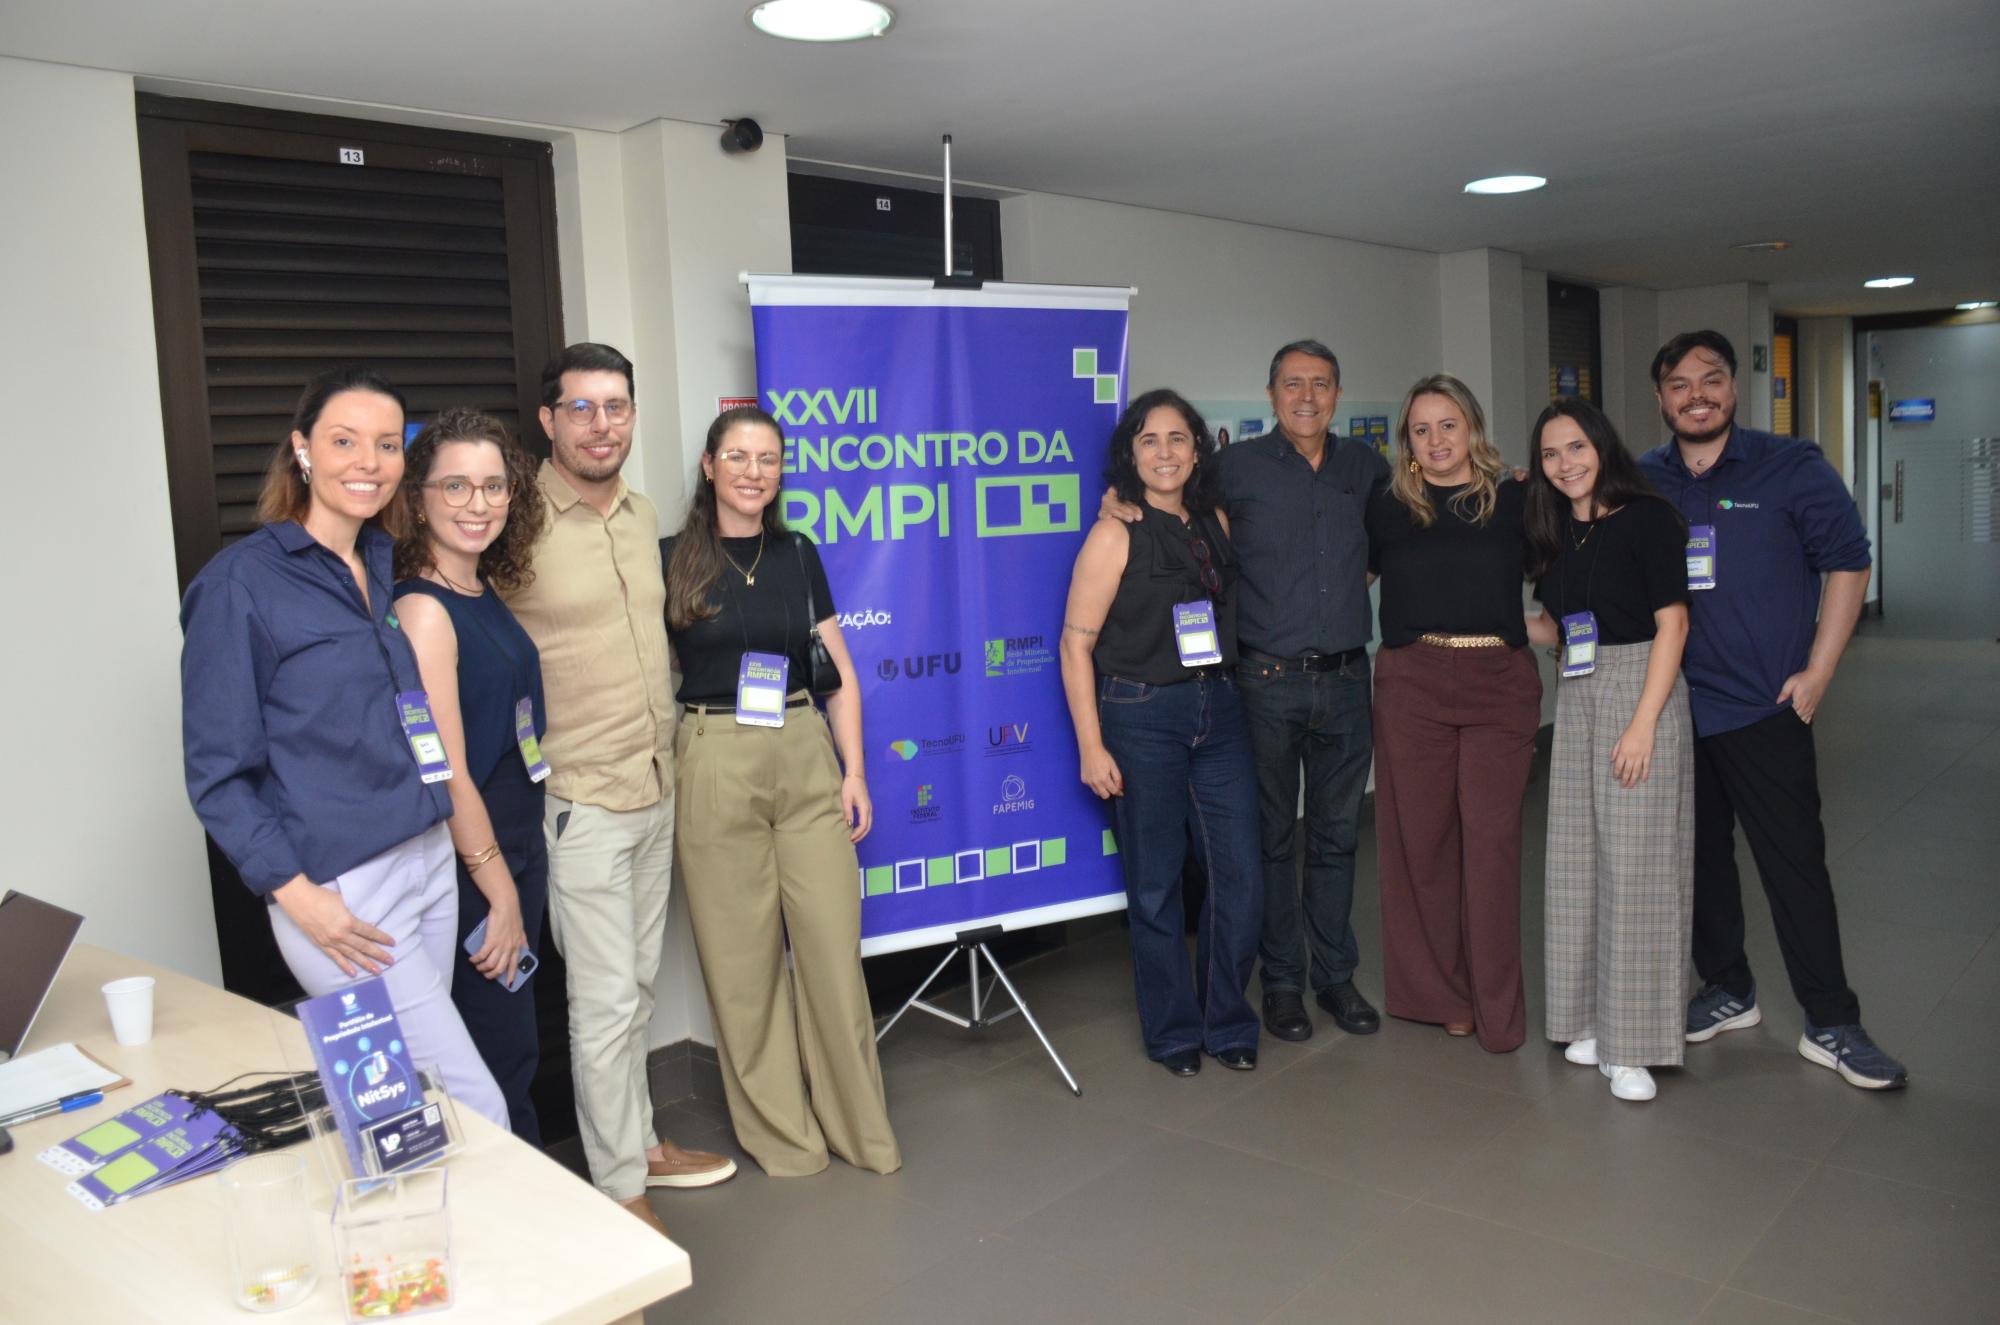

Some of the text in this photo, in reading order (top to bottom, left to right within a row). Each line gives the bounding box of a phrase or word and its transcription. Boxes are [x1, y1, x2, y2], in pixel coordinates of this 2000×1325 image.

[343, 151, 361, 163] 13
[879, 200, 889, 209] 14
[766, 388, 877, 425] XXVII
[782, 430, 1073, 473] ENCONTRO DA
[781, 482, 949, 545] RMPI
[1006, 636, 1043, 650] RMPI
[904, 652, 961, 679] UFU
[921, 734, 965, 748] TecnoUFU
[989, 723, 1029, 746] UFV
[993, 800, 1035, 815] FAPEMIG
[357, 1081, 406, 1108] NitSys
